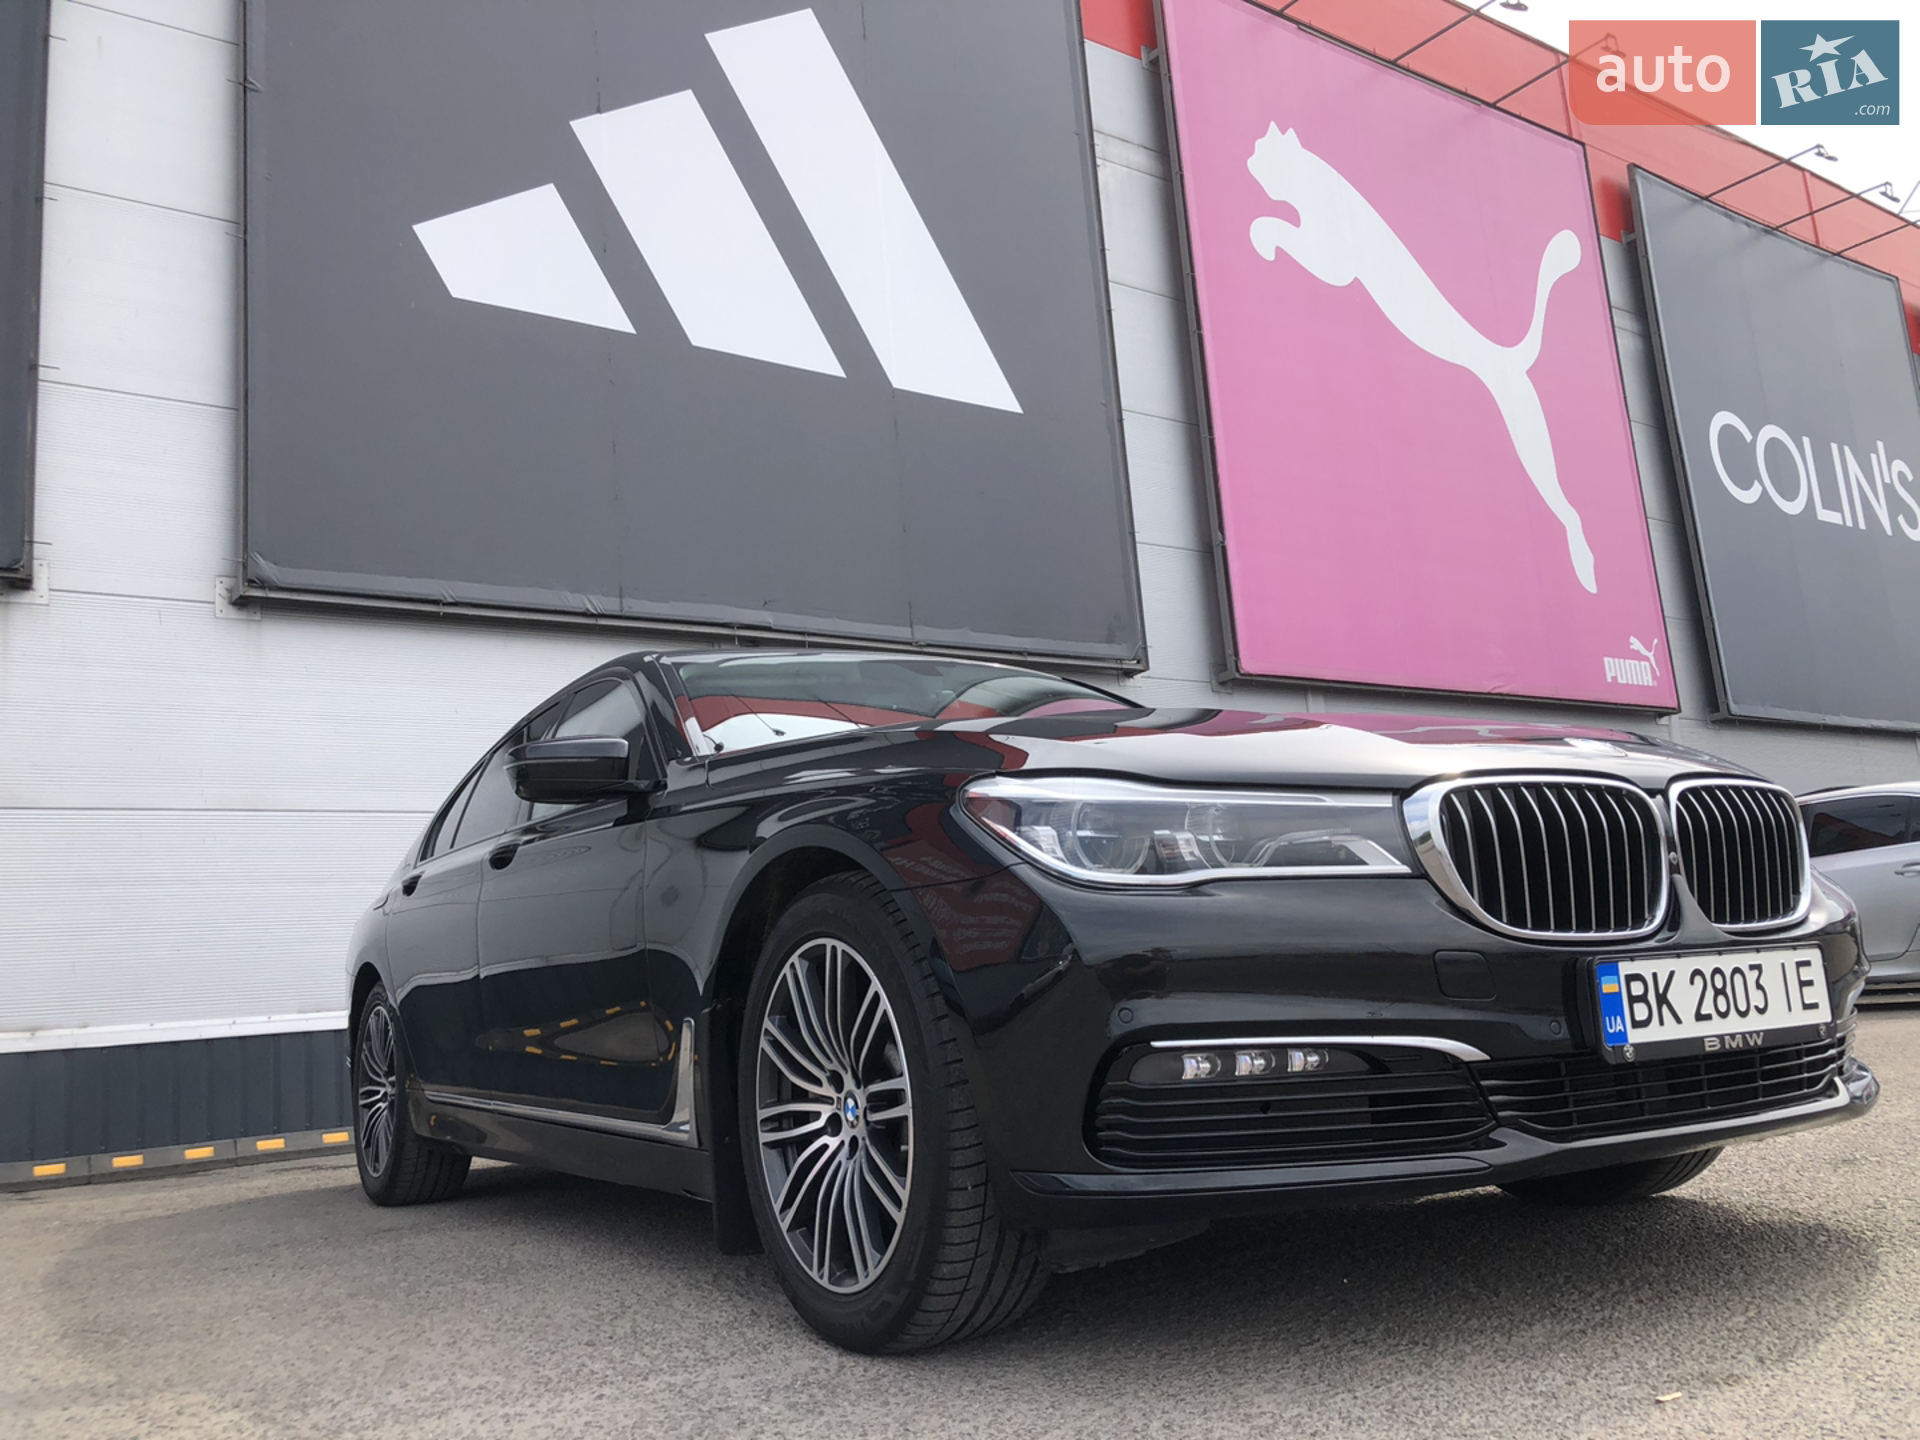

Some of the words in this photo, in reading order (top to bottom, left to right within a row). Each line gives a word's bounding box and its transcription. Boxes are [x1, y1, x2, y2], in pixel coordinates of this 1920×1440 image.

[1709, 410, 1920, 542] COLIN'S
[1603, 656, 1653, 686] PUMA
[1624, 970, 1683, 1029] BK
[1689, 963, 1768, 1022] 2803
[1781, 960, 1819, 1012] IE
[1605, 1016, 1624, 1034] UA
[1704, 1032, 1764, 1051] BMW
